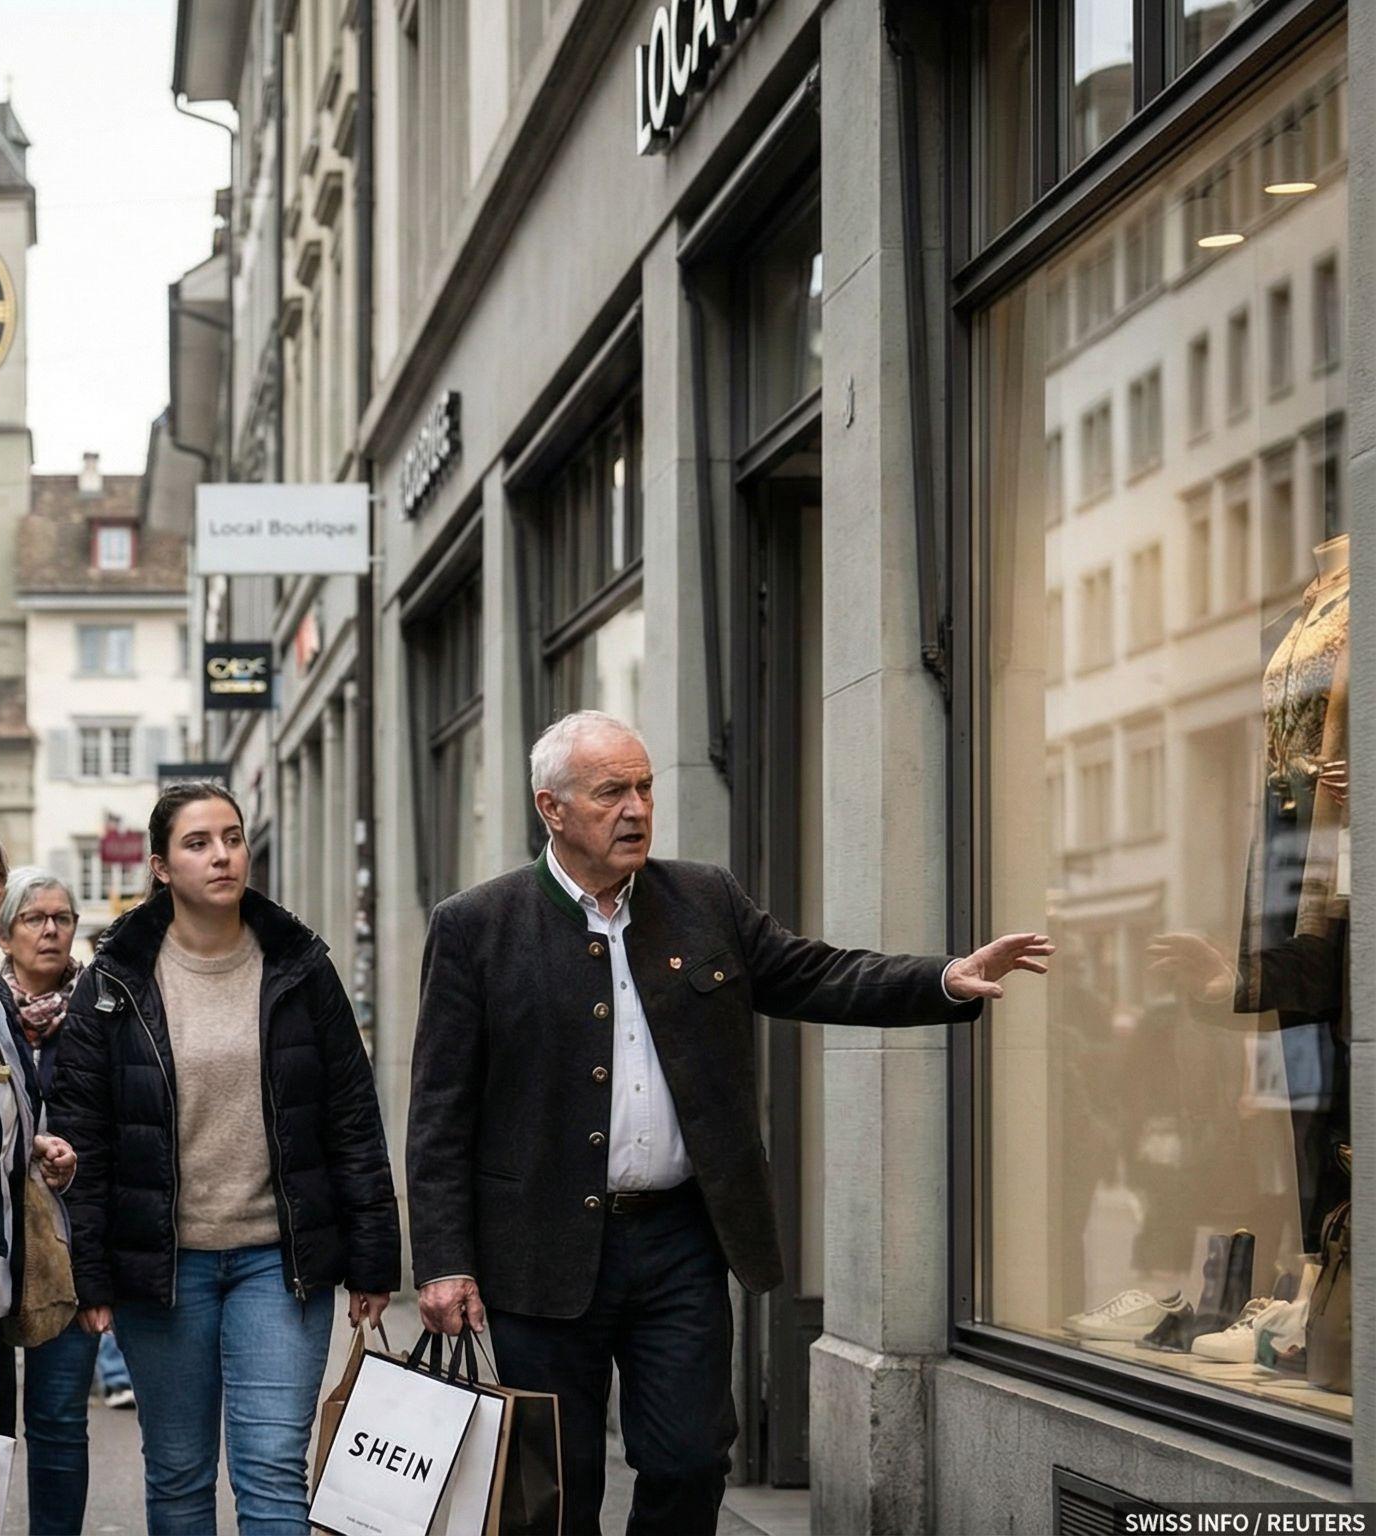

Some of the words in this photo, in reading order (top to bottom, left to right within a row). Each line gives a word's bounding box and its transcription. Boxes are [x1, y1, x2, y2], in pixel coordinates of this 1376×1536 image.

[635, 0, 738, 156] LOCA
[209, 518, 262, 538] Local
[268, 519, 357, 542] Boutique
[348, 1431, 434, 1483] SHEIN
